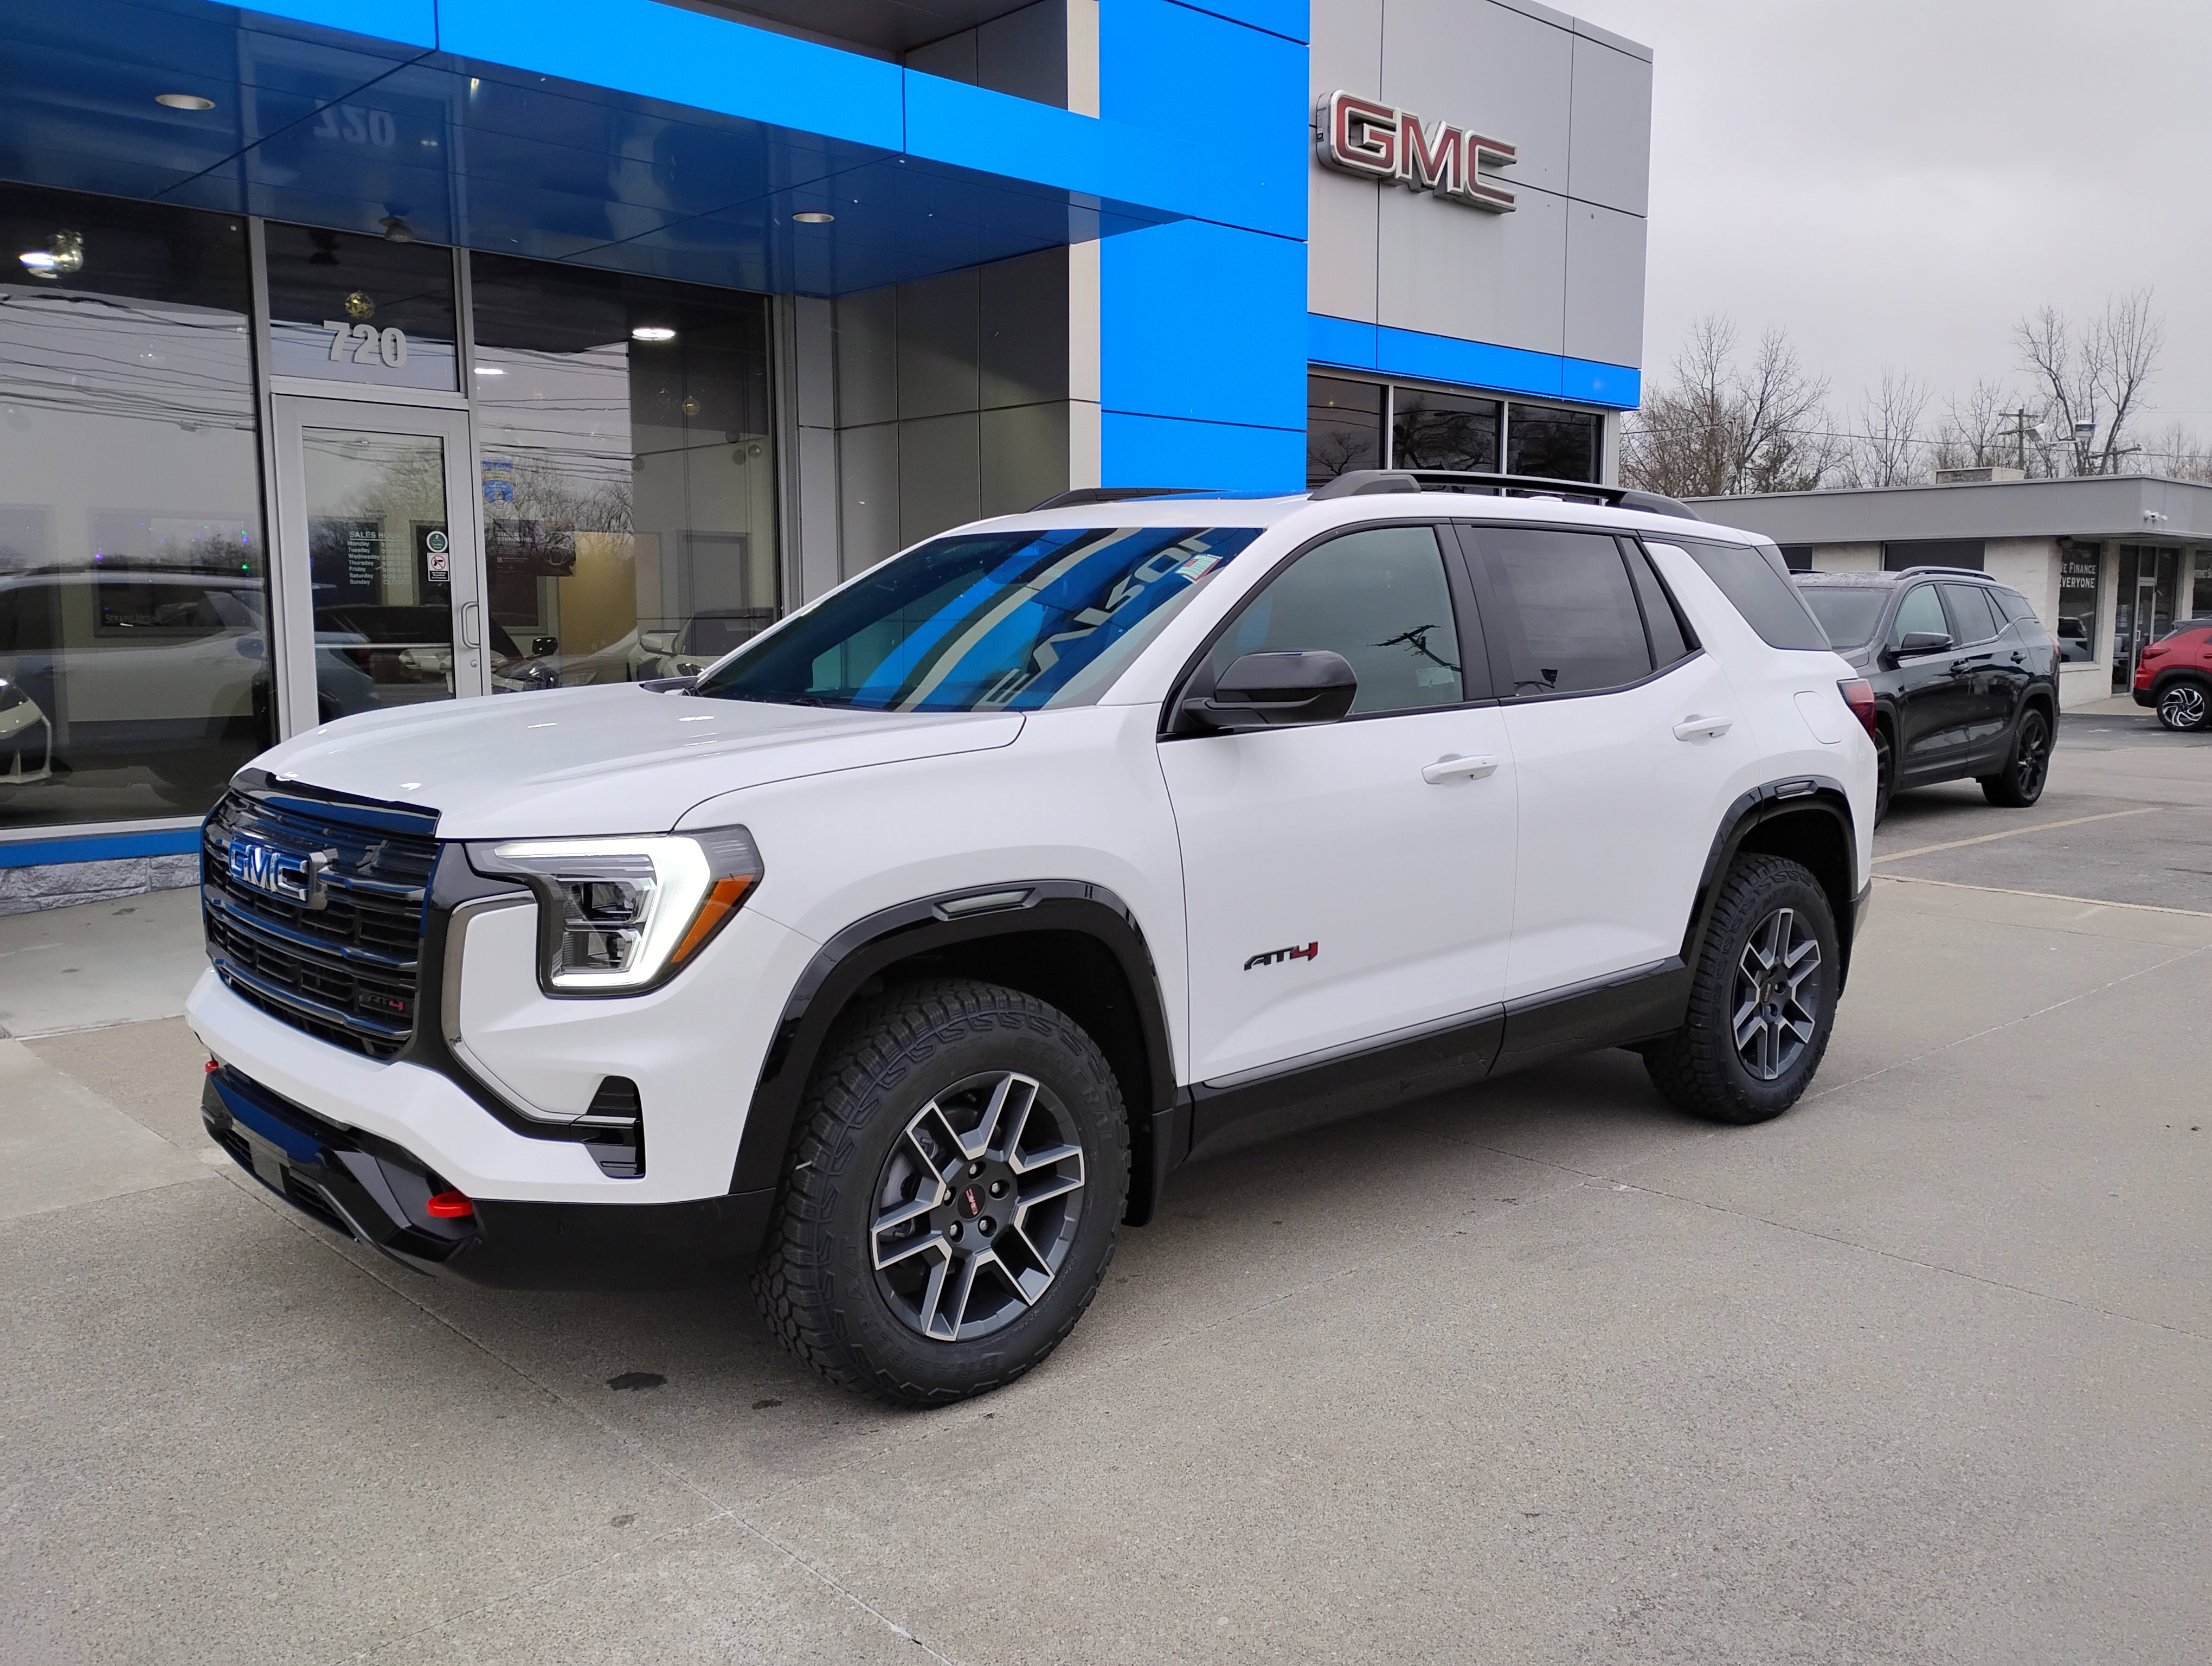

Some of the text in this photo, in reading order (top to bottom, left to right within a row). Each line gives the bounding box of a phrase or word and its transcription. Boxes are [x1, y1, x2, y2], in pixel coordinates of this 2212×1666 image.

[1316, 89, 1517, 214] GMC
[323, 320, 407, 368] 720
[2060, 575, 2095, 588] VERYONE
[2069, 562, 2097, 574] FINANCE
[229, 839, 310, 901] GMC
[1244, 941, 1319, 971] AT4
[368, 994, 404, 1011] AT4
[1011, 1035, 1115, 1149] GENERAL
